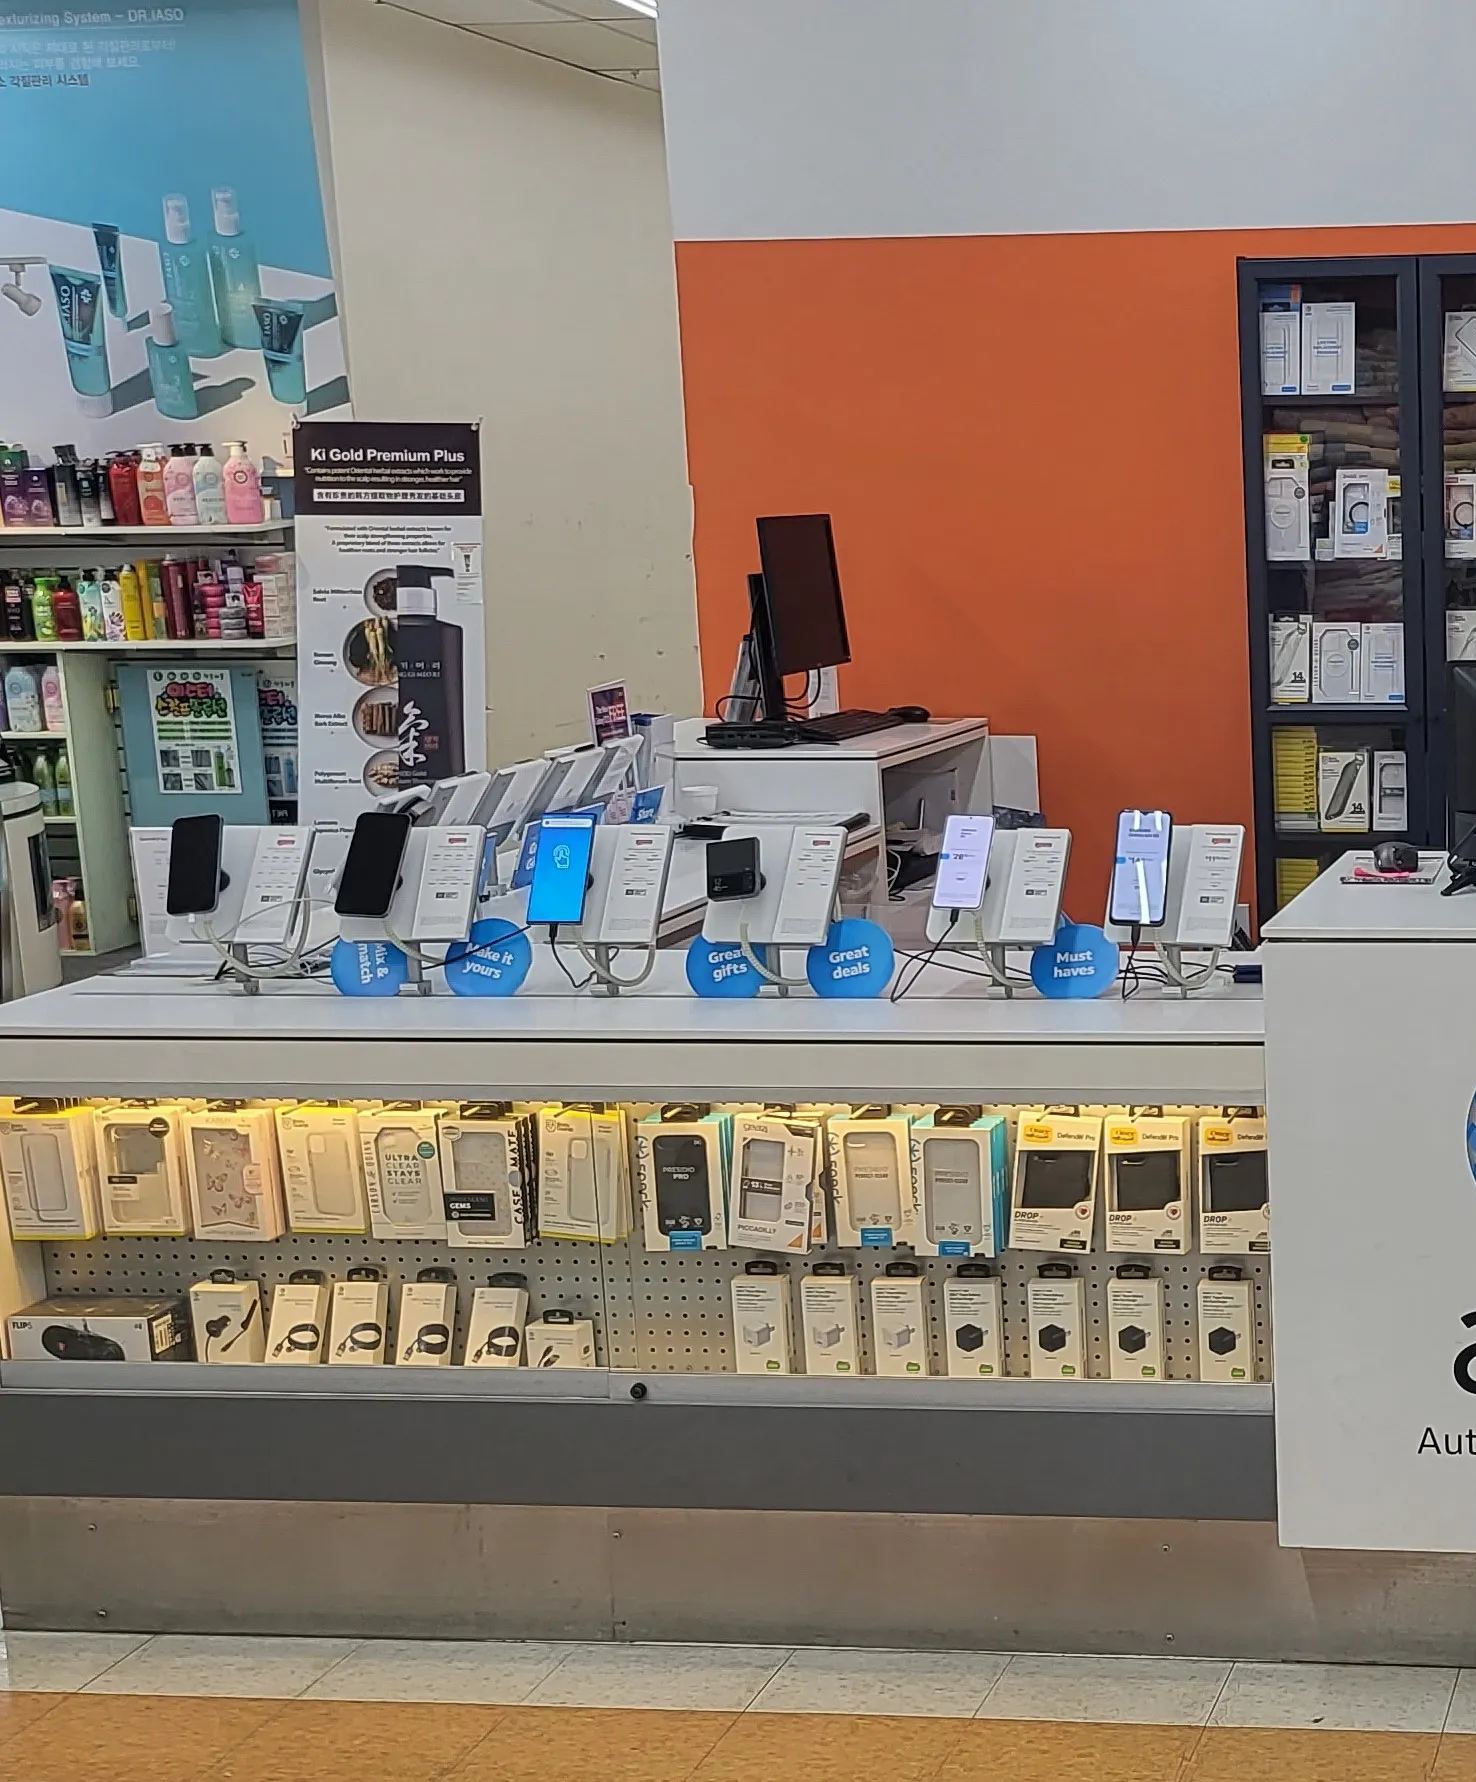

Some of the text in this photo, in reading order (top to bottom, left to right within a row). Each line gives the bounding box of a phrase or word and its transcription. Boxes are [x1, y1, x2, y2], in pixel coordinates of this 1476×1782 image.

[64, 11, 112, 26] System
[128, 8, 184, 22] DR.IASO
[11, 74, 90, 87] 각질관리 시스템
[311, 448, 465, 462] Ki Gold Premium Plus
[501, 951, 515, 966] it
[829, 946, 869, 964] Great
[1056, 951, 1094, 964] Must
[357, 943, 371, 985] match
[462, 960, 502, 979] yours
[832, 963, 870, 979] deals
[1053, 964, 1095, 978] haves
[376, 967, 389, 979] &
[713, 963, 747, 982] gifts
[385, 1153, 419, 1162] ULTRA
[386, 1162, 420, 1170] CLEAR
[508, 1130, 524, 1225] CASE MATE
[738, 1224, 777, 1234] PICCADILLY
